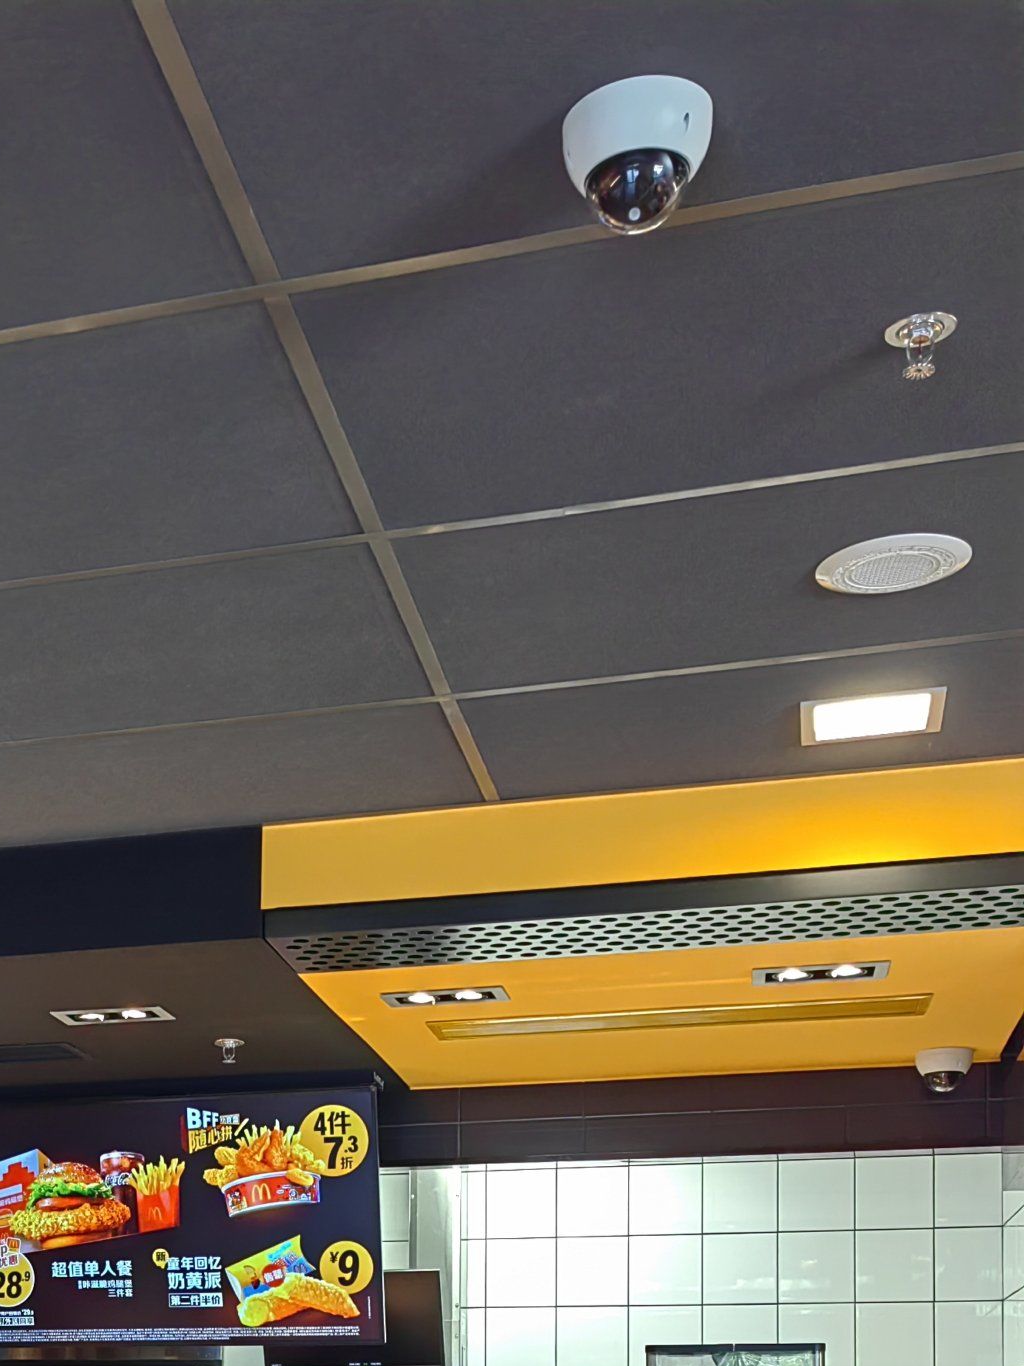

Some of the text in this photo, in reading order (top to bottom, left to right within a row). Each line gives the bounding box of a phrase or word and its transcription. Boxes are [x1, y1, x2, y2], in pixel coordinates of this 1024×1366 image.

[186, 1107, 219, 1130] BFF
[314, 1111, 351, 1136] 4件
[51, 1260, 133, 1278] 超值单人餐
[167, 1256, 222, 1271] 童年回忆
[330, 1249, 360, 1287] ¥9
[167, 1271, 222, 1290] 奶黄派
[108, 1289, 133, 1298] 三件套
[170, 1295, 222, 1307] 第二件半价
